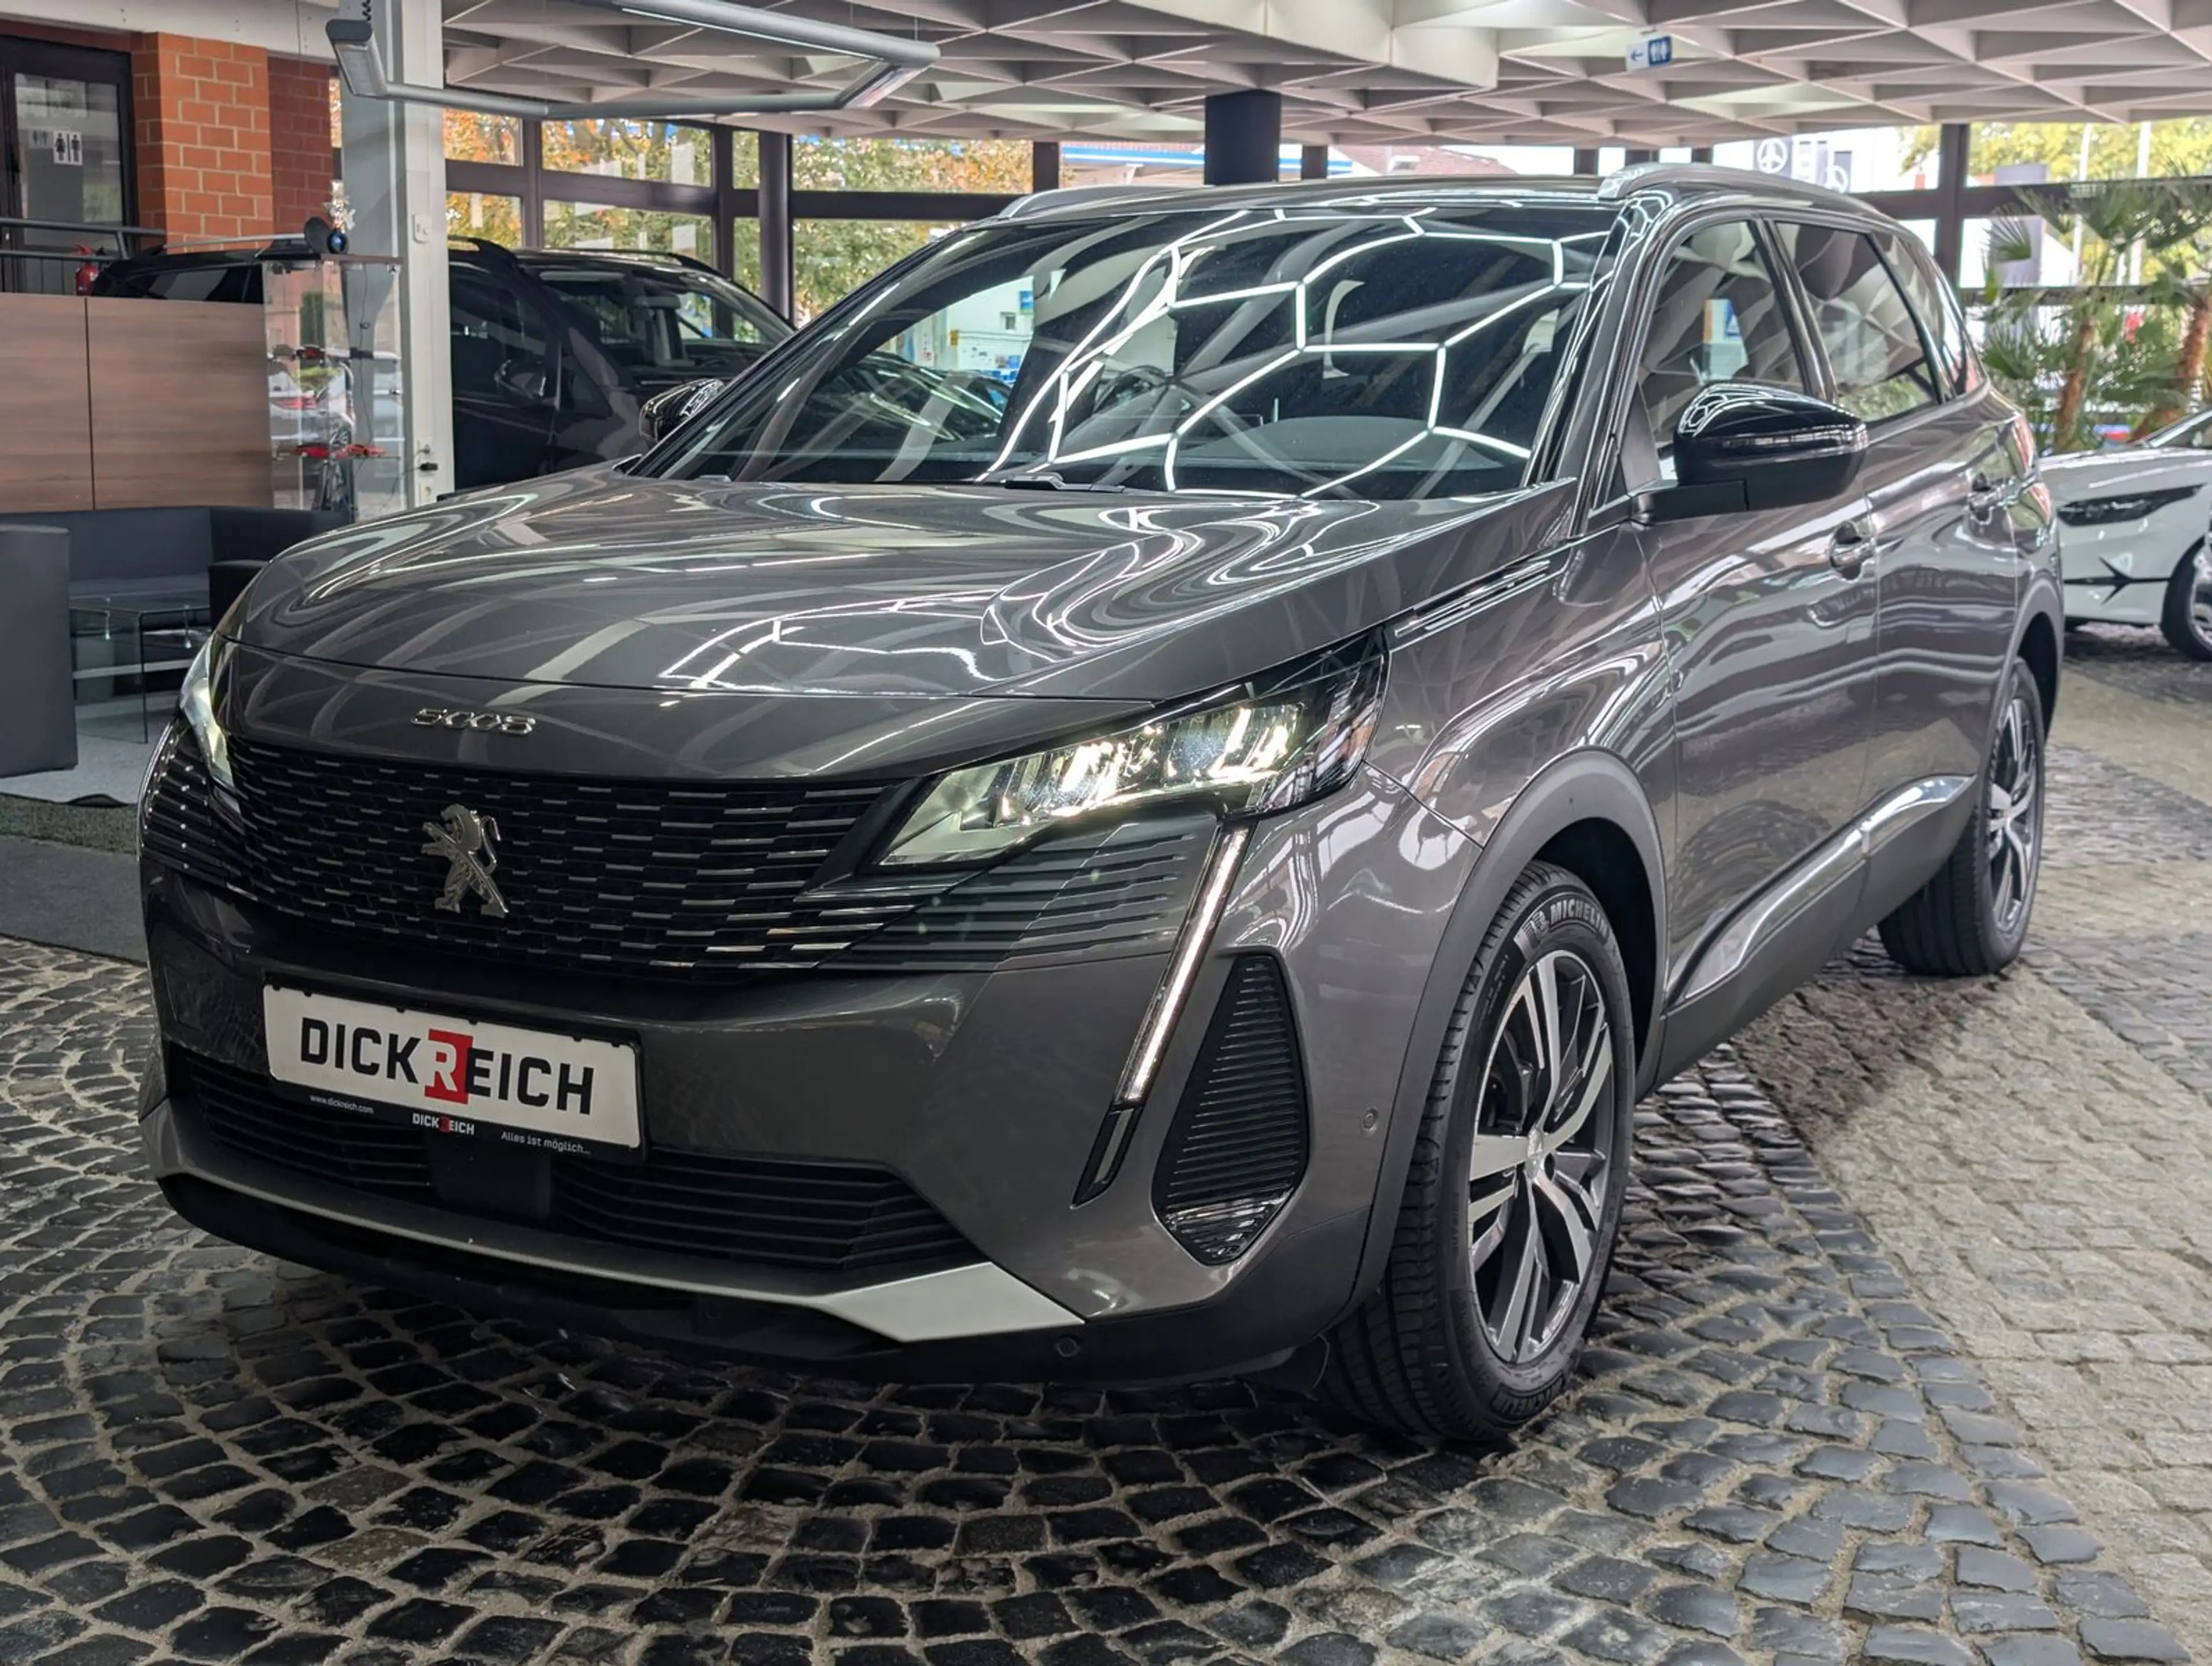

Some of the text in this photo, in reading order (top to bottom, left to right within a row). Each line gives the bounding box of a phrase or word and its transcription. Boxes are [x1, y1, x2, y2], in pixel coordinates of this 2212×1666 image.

[410, 708, 536, 735] 5008
[1550, 898, 1610, 939] MICHELIN
[300, 1017, 595, 1115] DICKREICH
[501, 1130, 525, 1144] Alles
[527, 1134, 542, 1147] ist
